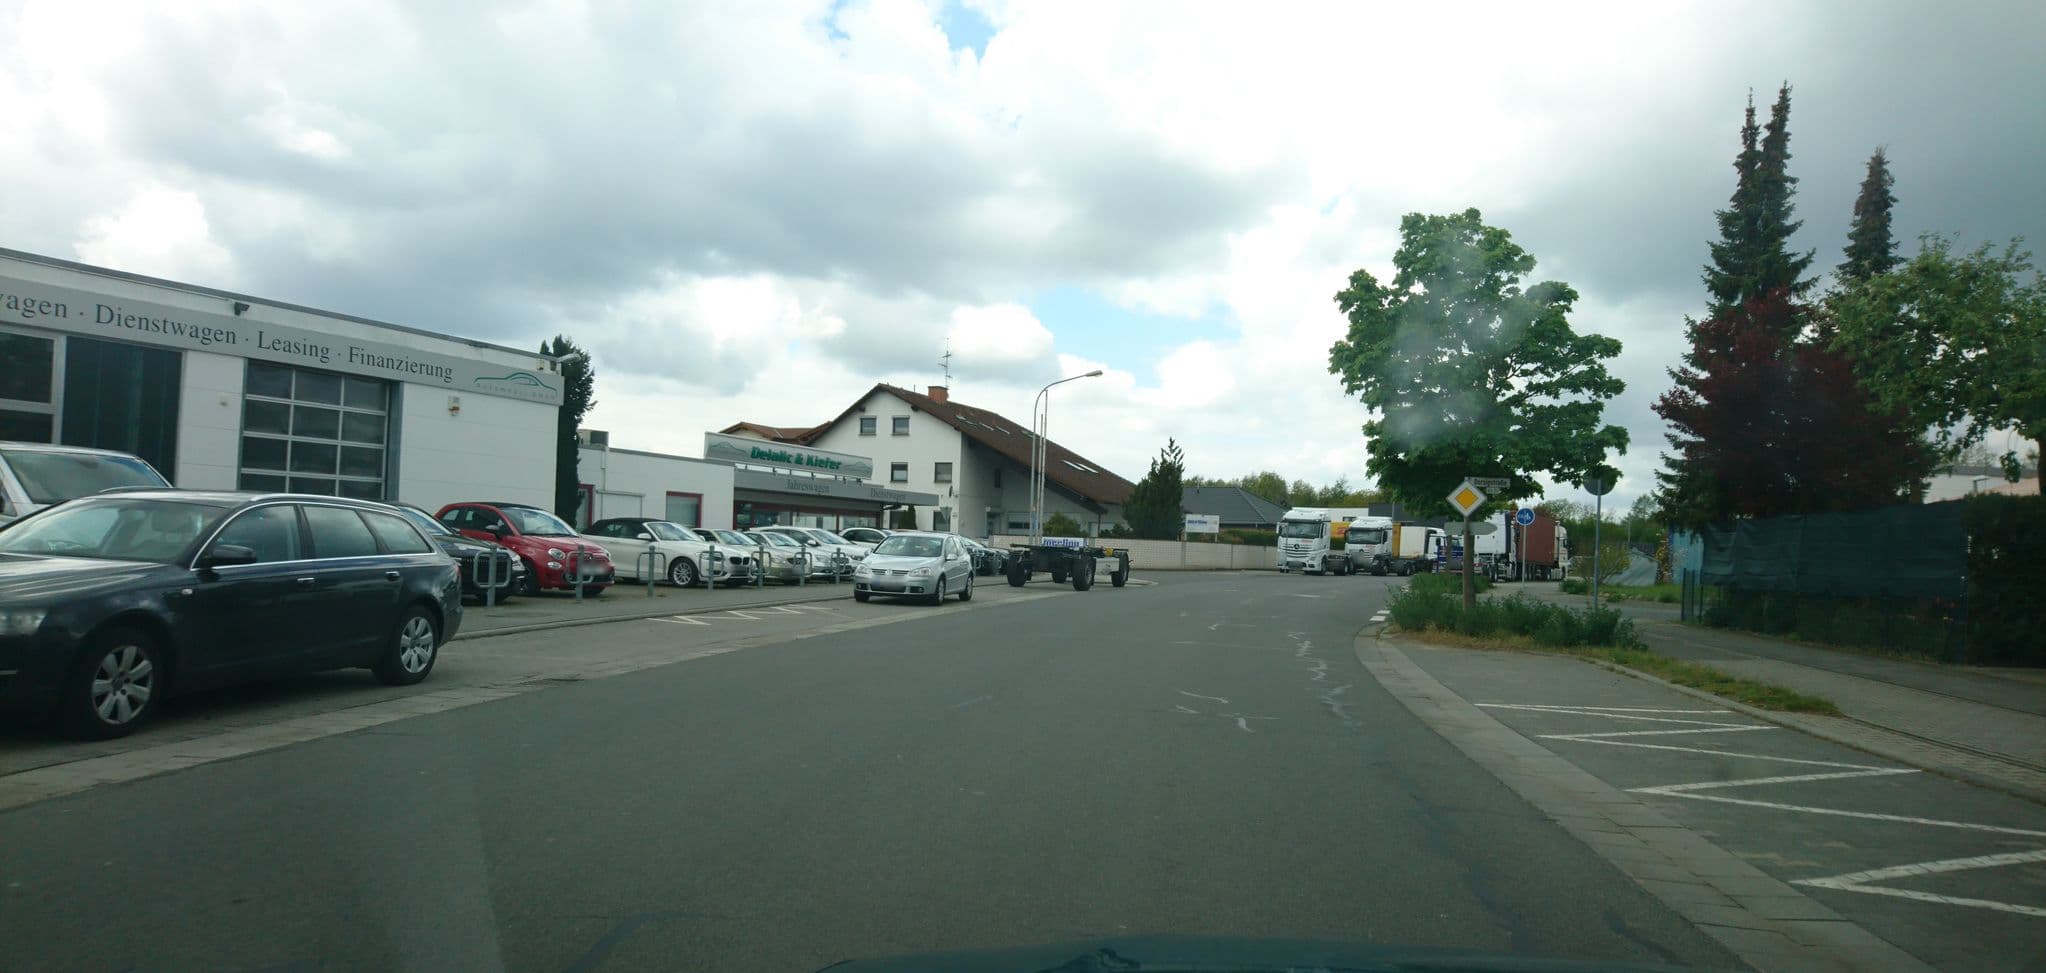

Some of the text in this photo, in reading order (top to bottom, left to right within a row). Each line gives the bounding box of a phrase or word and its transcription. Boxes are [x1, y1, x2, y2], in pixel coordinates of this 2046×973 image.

[96, 303, 236, 345] Dienstwagen
[257, 330, 330, 364] Leasing
[348, 346, 453, 382] Finanzierung
[806, 454, 842, 470] Kiefer
[786, 478, 830, 495] Jahreswagen
